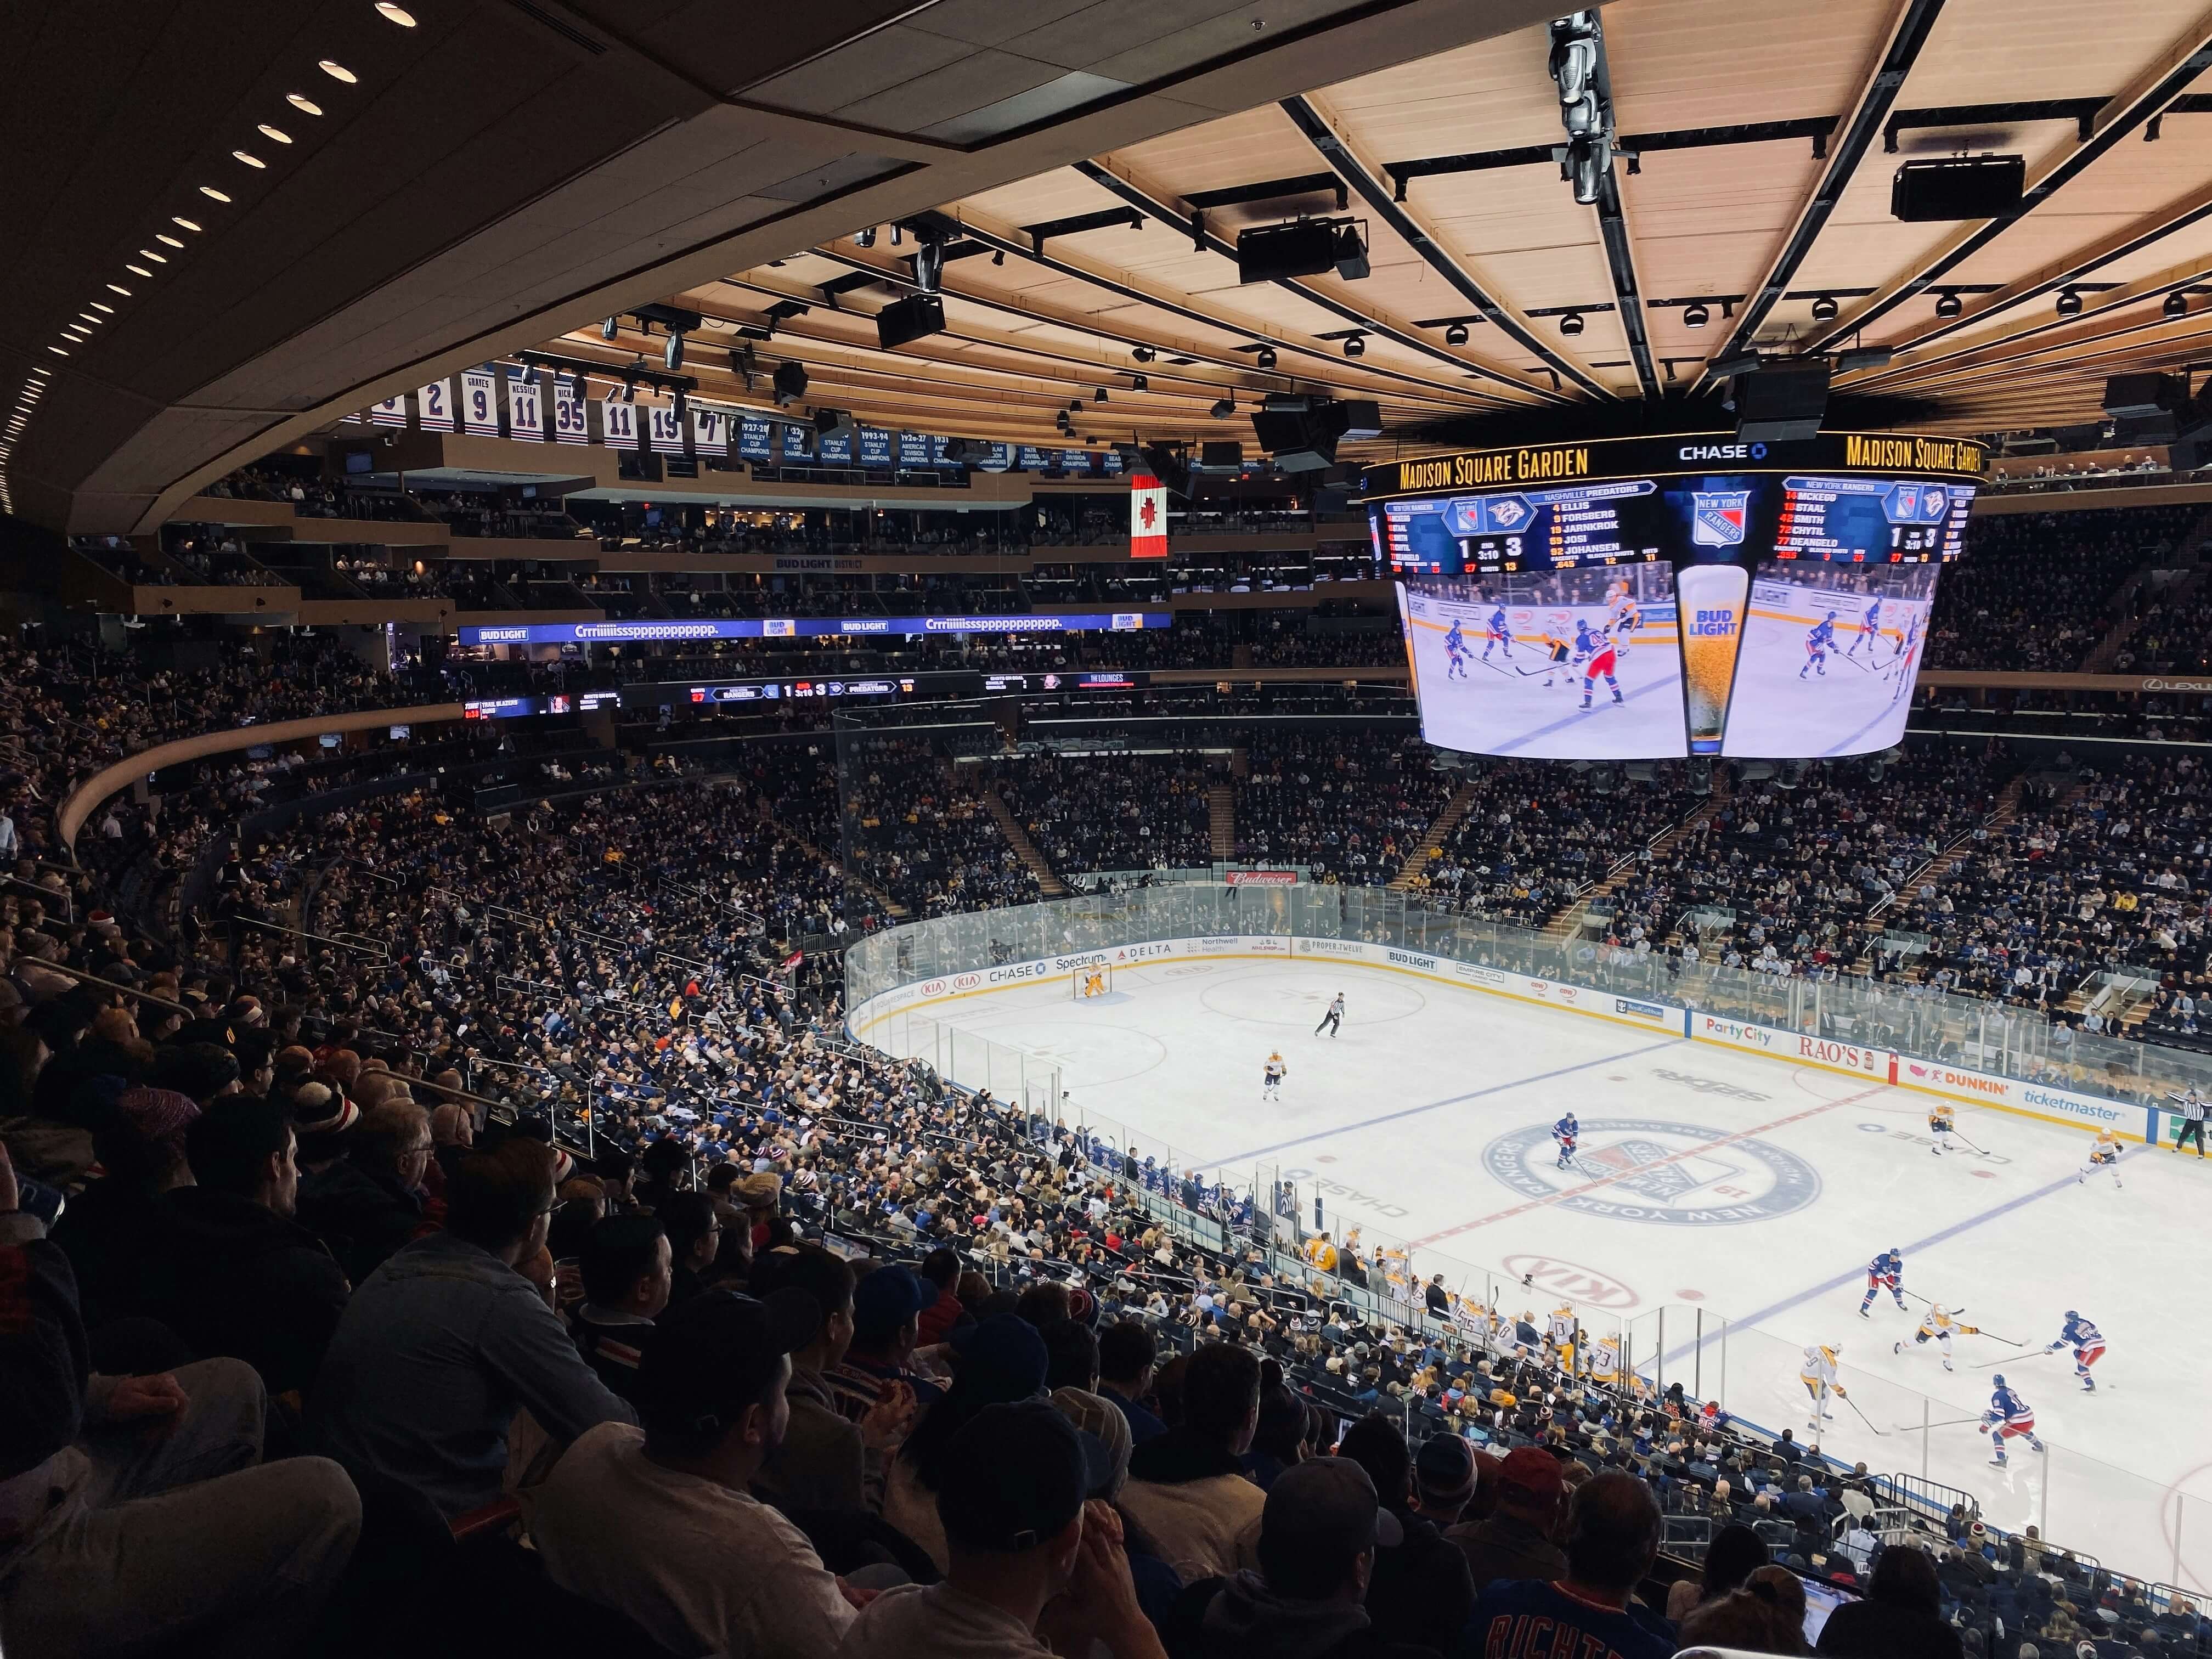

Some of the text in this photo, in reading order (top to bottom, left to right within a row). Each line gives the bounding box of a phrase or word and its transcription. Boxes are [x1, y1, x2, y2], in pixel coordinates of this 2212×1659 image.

[468, 377, 489, 388] GRAVES
[512, 385, 536, 396] MESSIER
[427, 384, 443, 416] 2
[473, 390, 487, 421] 9
[515, 397, 537, 428] 11
[557, 400, 584, 431] 35
[609, 407, 631, 437] 11
[653, 410, 678, 439] 19
[704, 414, 715, 442] 7
[861, 432, 888, 441] 1993-94
[1679, 445, 1747, 461] CHASE
[1847, 436, 1912, 467] MADISON
[1915, 438, 1955, 471] SQUARE
[1400, 448, 1588, 490] MADISON SQUARE GARDEN
[1544, 485, 1639, 501] NASHVILLE PREDATORS
[1807, 481, 1875, 492] NEW YORK RANGERS
[1553, 501, 1590, 512] 4 ELLIS
[1699, 498, 1743, 508] NEW YORK
[1795, 503, 1826, 513] STAAL
[1554, 510, 1616, 523] 9 FORSBERG
[1780, 514, 1824, 524] 42 SMITH
[1550, 521, 1620, 534] 19 JARNKROK
[1705, 511, 1740, 539] RANGERS
[1779, 525, 1826, 535] 72 CHYTIL
[1564, 535, 1587, 544] JOSI
[1778, 537, 1838, 548] 77 DEANGELO
[1892, 527, 1901, 547] 1
[1925, 528, 1936, 548] 3
[1459, 540, 1469, 558] 1
[1505, 537, 1522, 556] 3
[1565, 543, 1620, 555] JOHANSEN
[1905, 540, 1921, 550] 3:10
[1478, 550, 1499, 560] 3:10
[1555, 553, 1656, 569] .645 12 11
[1587, 551, 1613, 560] BLOCKED
[1891, 553, 1902, 562] 27
[776, 560, 862, 569] BUD LIGHT DISTRICT
[1464, 563, 1476, 572] 27
[1505, 562, 1517, 571] 13
[1697, 610, 1733, 623] BUD
[843, 622, 887, 631] BUD LIGHT
[1689, 623, 1738, 635] LIGHT
[481, 630, 527, 640] BUD LIGHT
[1098, 674, 1124, 682] LOUNGES
[784, 685, 792, 697] 1
[795, 689, 813, 697] 3:10
[815, 683, 826, 696] 3
[902, 684, 913, 692] 13
[2165, 682, 2212, 691] LEXU
[691, 693, 705, 702] 27
[723, 691, 755, 699] RANGERS
[1231, 872, 1293, 884] Budweiser
[1202, 937, 1238, 945] Northwell
[1312, 941, 1336, 950] PROPER
[1340, 944, 1363, 953] TWELVE
[1130, 944, 1171, 957] DELTA
[1057, 953, 1103, 972] Spectrum
[1389, 951, 1436, 969] BUD LIGHT
[990, 966, 1032, 982] CHASE
[1459, 966, 1485, 975] EMPIRE
[925, 982, 943, 994] KIA
[958, 976, 976, 987] KIA
[877, 990, 916, 1009] SQUARESPACE
[1799, 1036, 1859, 1067] RAO'S
[1945, 1072, 2010, 1096] DUNKIN'
[2024, 1090, 2120, 1121] ticketmaster
[1494, 1143, 1552, 1194] RANGERS
[1308, 1178, 1409, 1217] CHASE
[1713, 1186, 1751, 1199] 19
[1570, 1197, 1774, 1221] NEW YORK
[1525, 1260, 1623, 1302] KIA
[1499, 1326, 1510, 1338] 8
[1555, 1322, 1565, 1336] 13
[1485, 1615, 1624, 1659] RICHT
